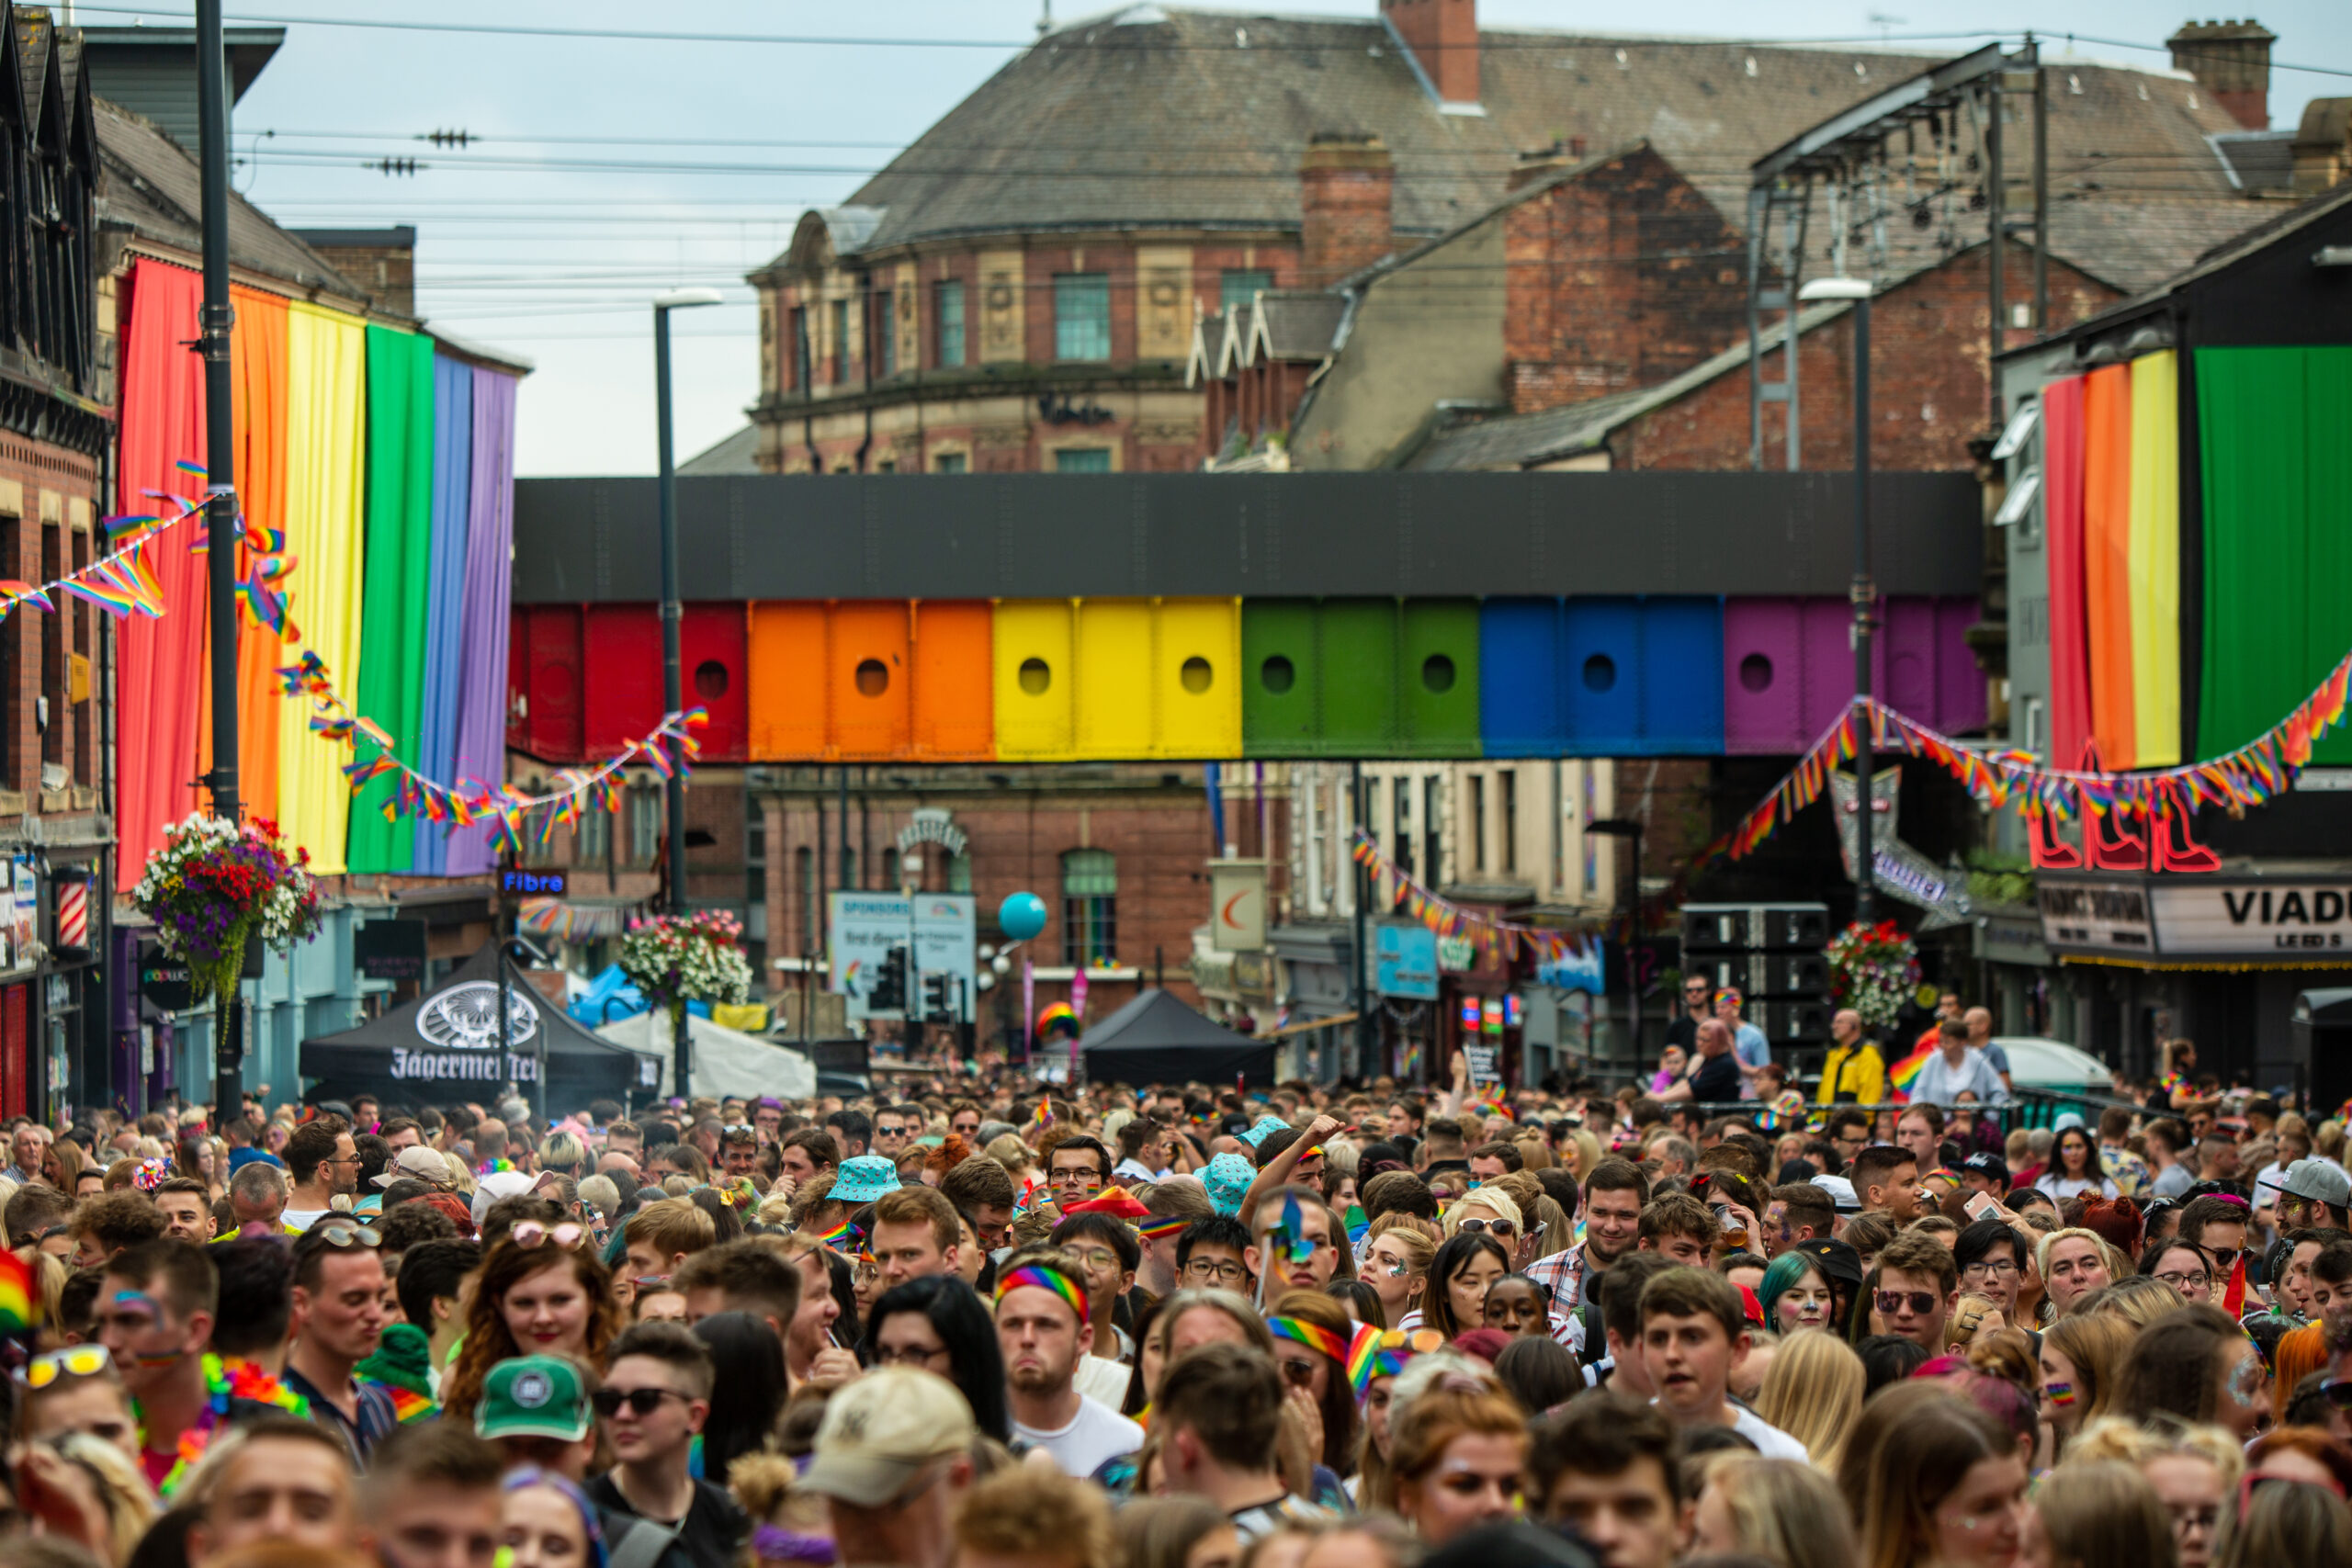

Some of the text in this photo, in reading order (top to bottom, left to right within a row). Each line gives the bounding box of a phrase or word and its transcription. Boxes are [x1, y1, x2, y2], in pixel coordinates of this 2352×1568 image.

[503, 872, 564, 892] Fibre
[2222, 891, 2352, 925] VIAD
[2275, 933, 2343, 948] LEEDS
[390, 1046, 537, 1082] Jägermeiter
